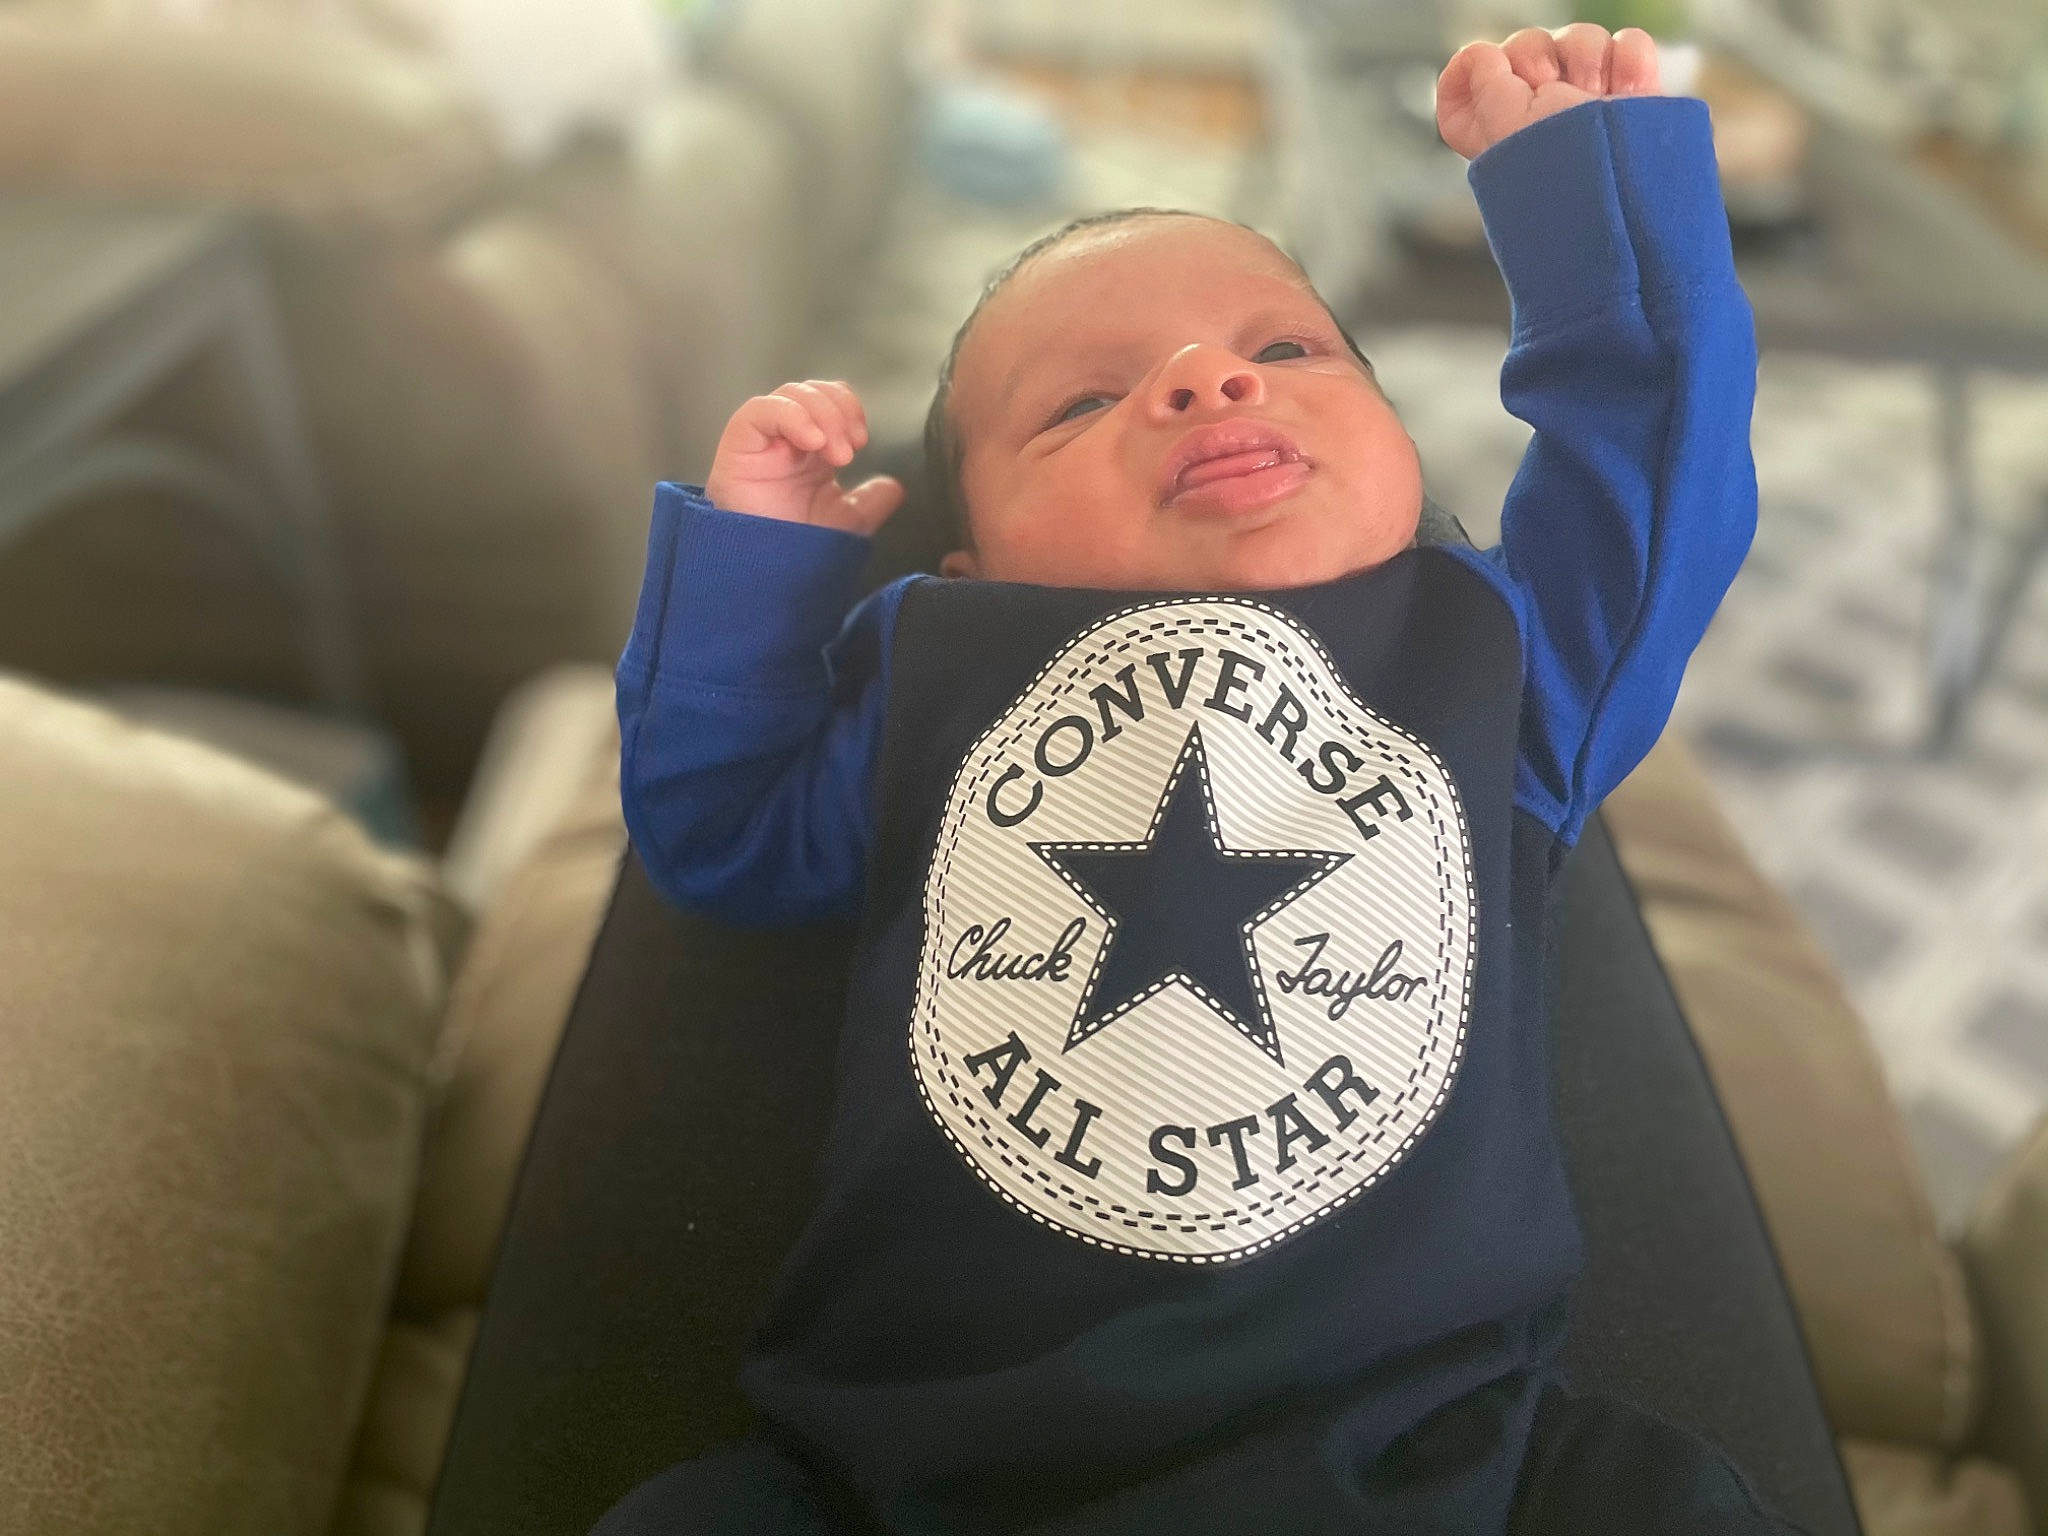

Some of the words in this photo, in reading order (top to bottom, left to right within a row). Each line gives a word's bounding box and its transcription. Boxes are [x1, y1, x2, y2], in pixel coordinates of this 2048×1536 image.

[985, 648, 1413, 840] CONVERSE
[947, 917, 1087, 983] Chuck
[1276, 932, 1429, 1020] Taylor
[963, 1031, 1103, 1180] ALL
[1146, 1054, 1380, 1197] STAR
